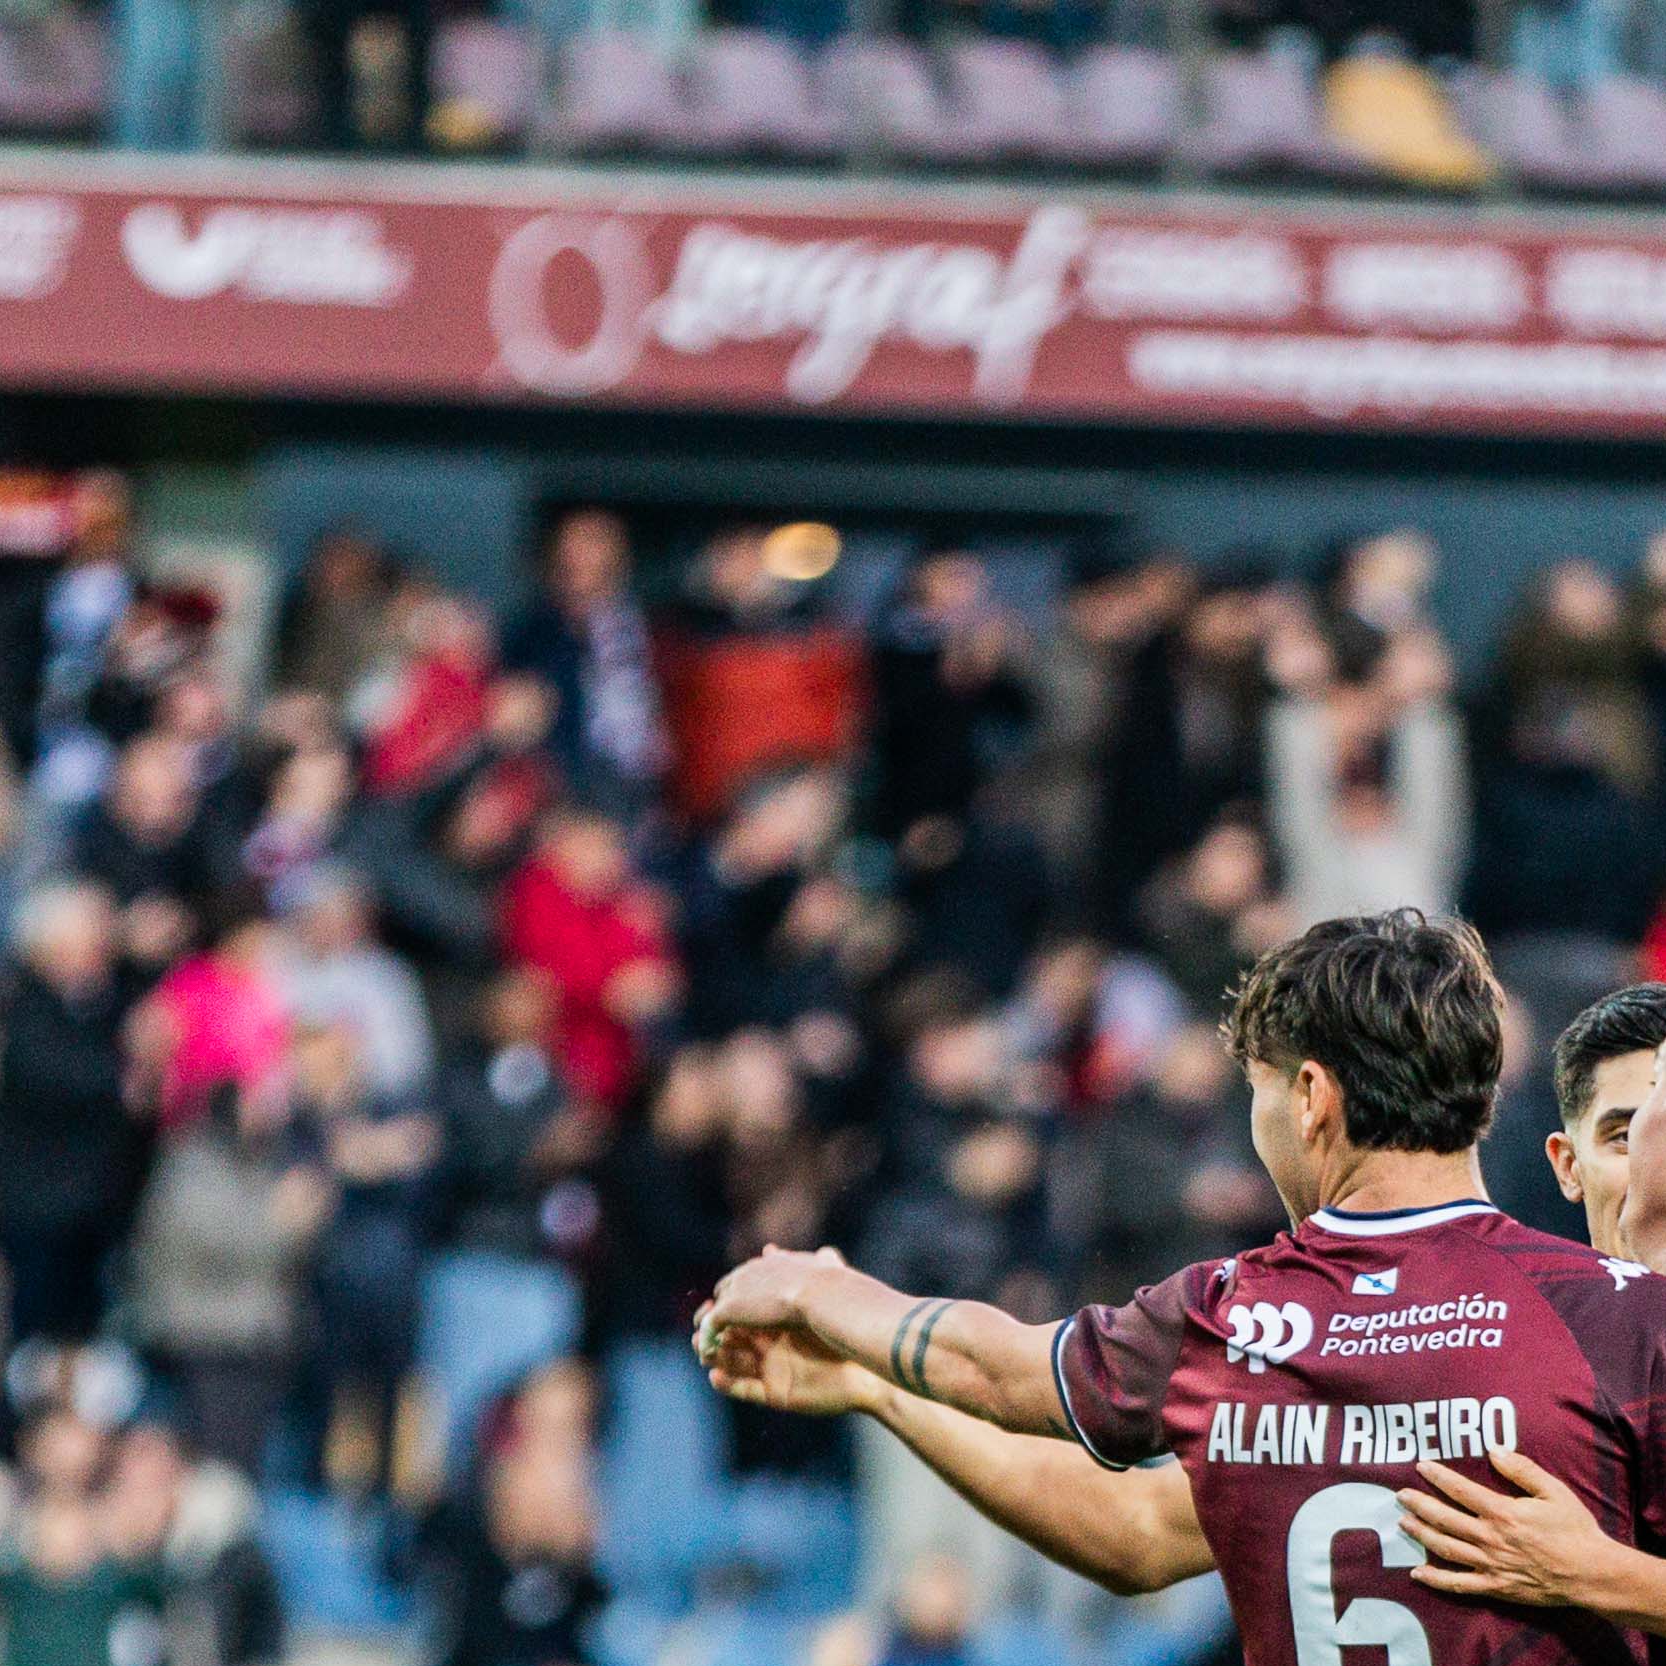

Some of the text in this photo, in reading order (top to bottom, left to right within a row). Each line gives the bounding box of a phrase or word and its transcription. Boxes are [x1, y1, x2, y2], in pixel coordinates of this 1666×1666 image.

[1327, 1292, 1508, 1337] Deputación
[1319, 1323, 1503, 1357] Pontevedra
[1207, 1396, 1518, 1465] ALAIN RIBEIRO
